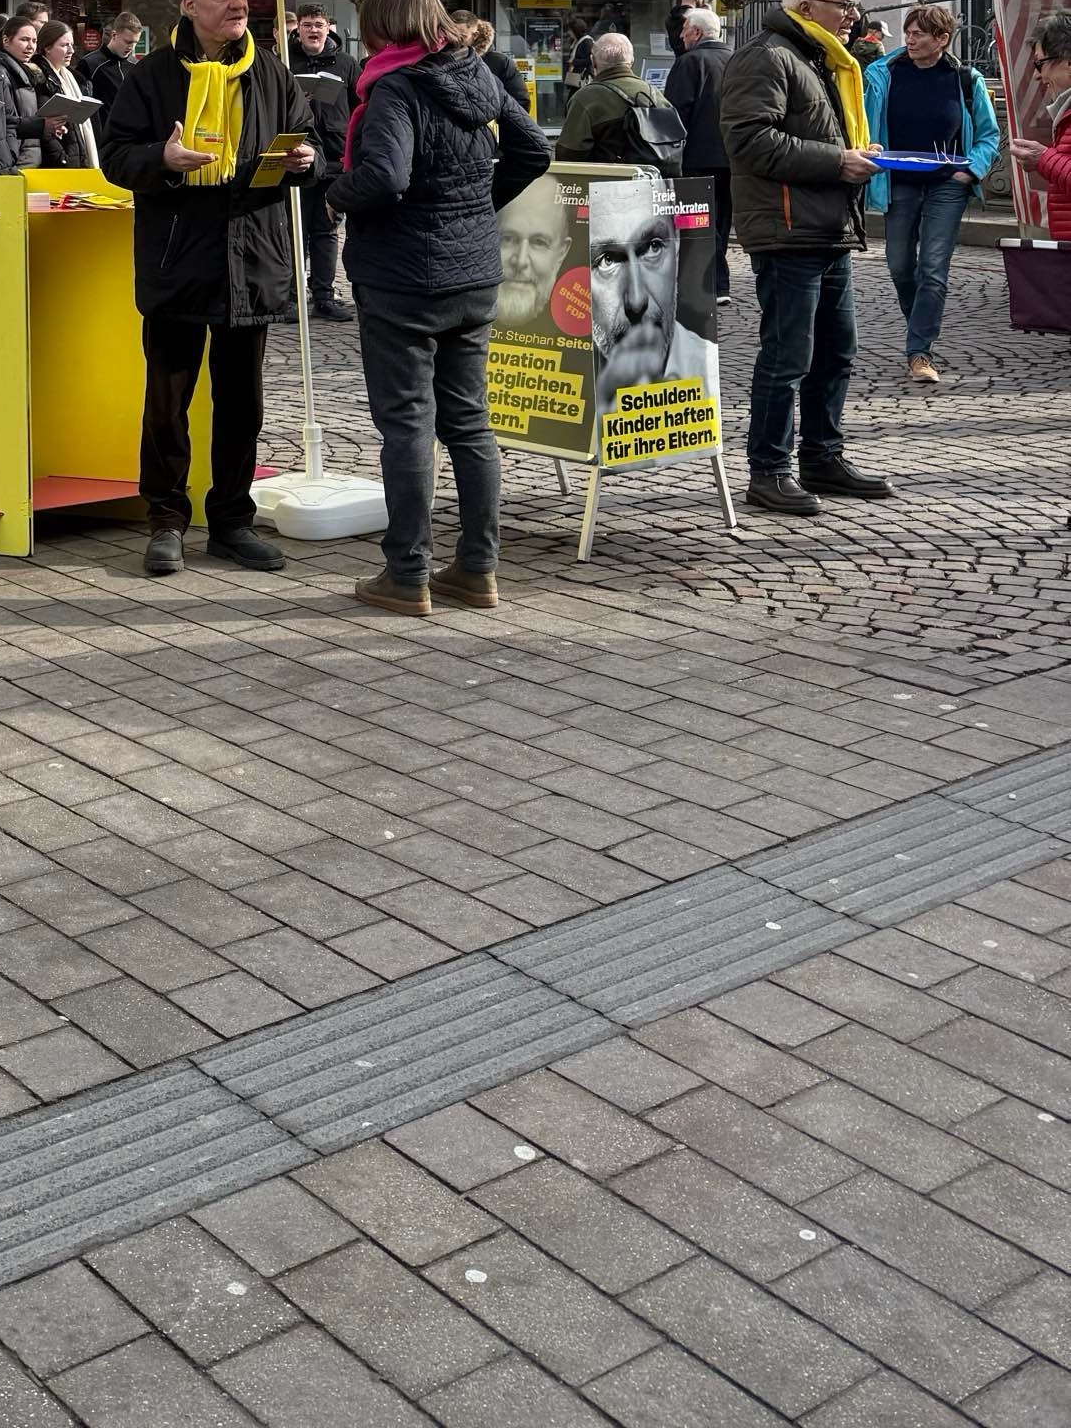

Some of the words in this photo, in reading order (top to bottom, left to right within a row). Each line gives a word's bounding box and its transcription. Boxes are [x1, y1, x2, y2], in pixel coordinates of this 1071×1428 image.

[556, 182, 583, 194] Freie
[652, 188, 676, 203] Freie
[652, 201, 710, 216] Demokraten
[695, 216, 708, 228] FDP
[566, 304, 586, 320] FDP
[489, 328, 504, 340] Dr.
[505, 330, 554, 346] Stephan
[621, 387, 701, 412] Schulden:
[607, 415, 661, 437] Kinder
[664, 407, 714, 428] haften
[606, 441, 631, 461] für
[634, 437, 666, 456] ihre
[669, 429, 717, 450] Eltern.
